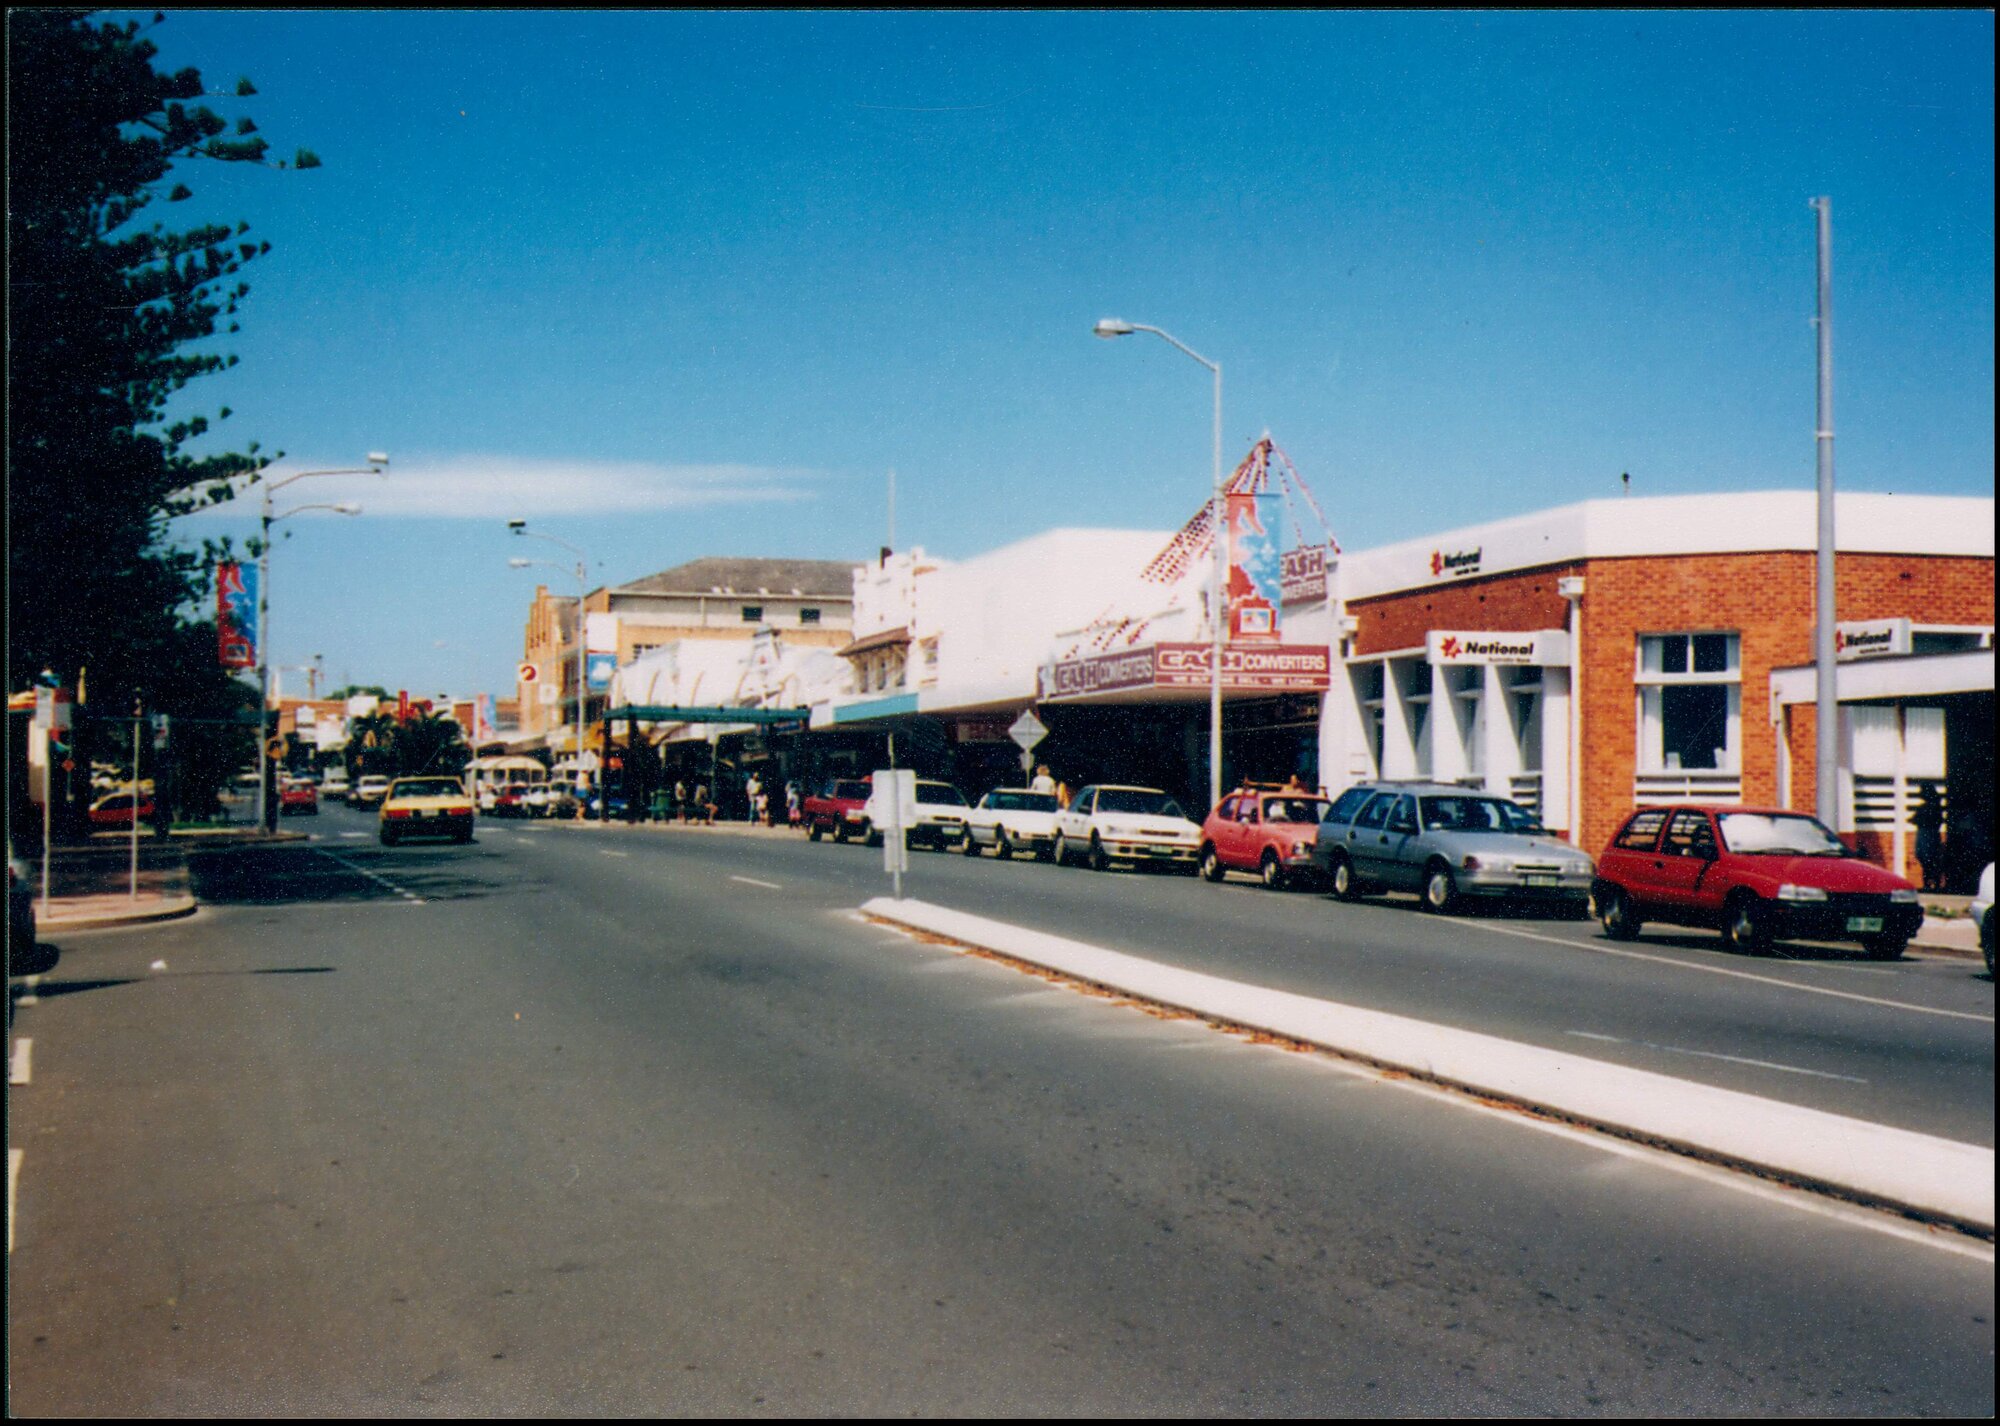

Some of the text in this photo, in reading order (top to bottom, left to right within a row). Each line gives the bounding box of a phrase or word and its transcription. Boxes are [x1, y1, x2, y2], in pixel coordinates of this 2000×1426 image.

[1444, 546, 1482, 568] National
[1845, 627, 1892, 646] National
[1465, 641, 1534, 655] National
[1246, 654, 1327, 670] CONVERTERS
